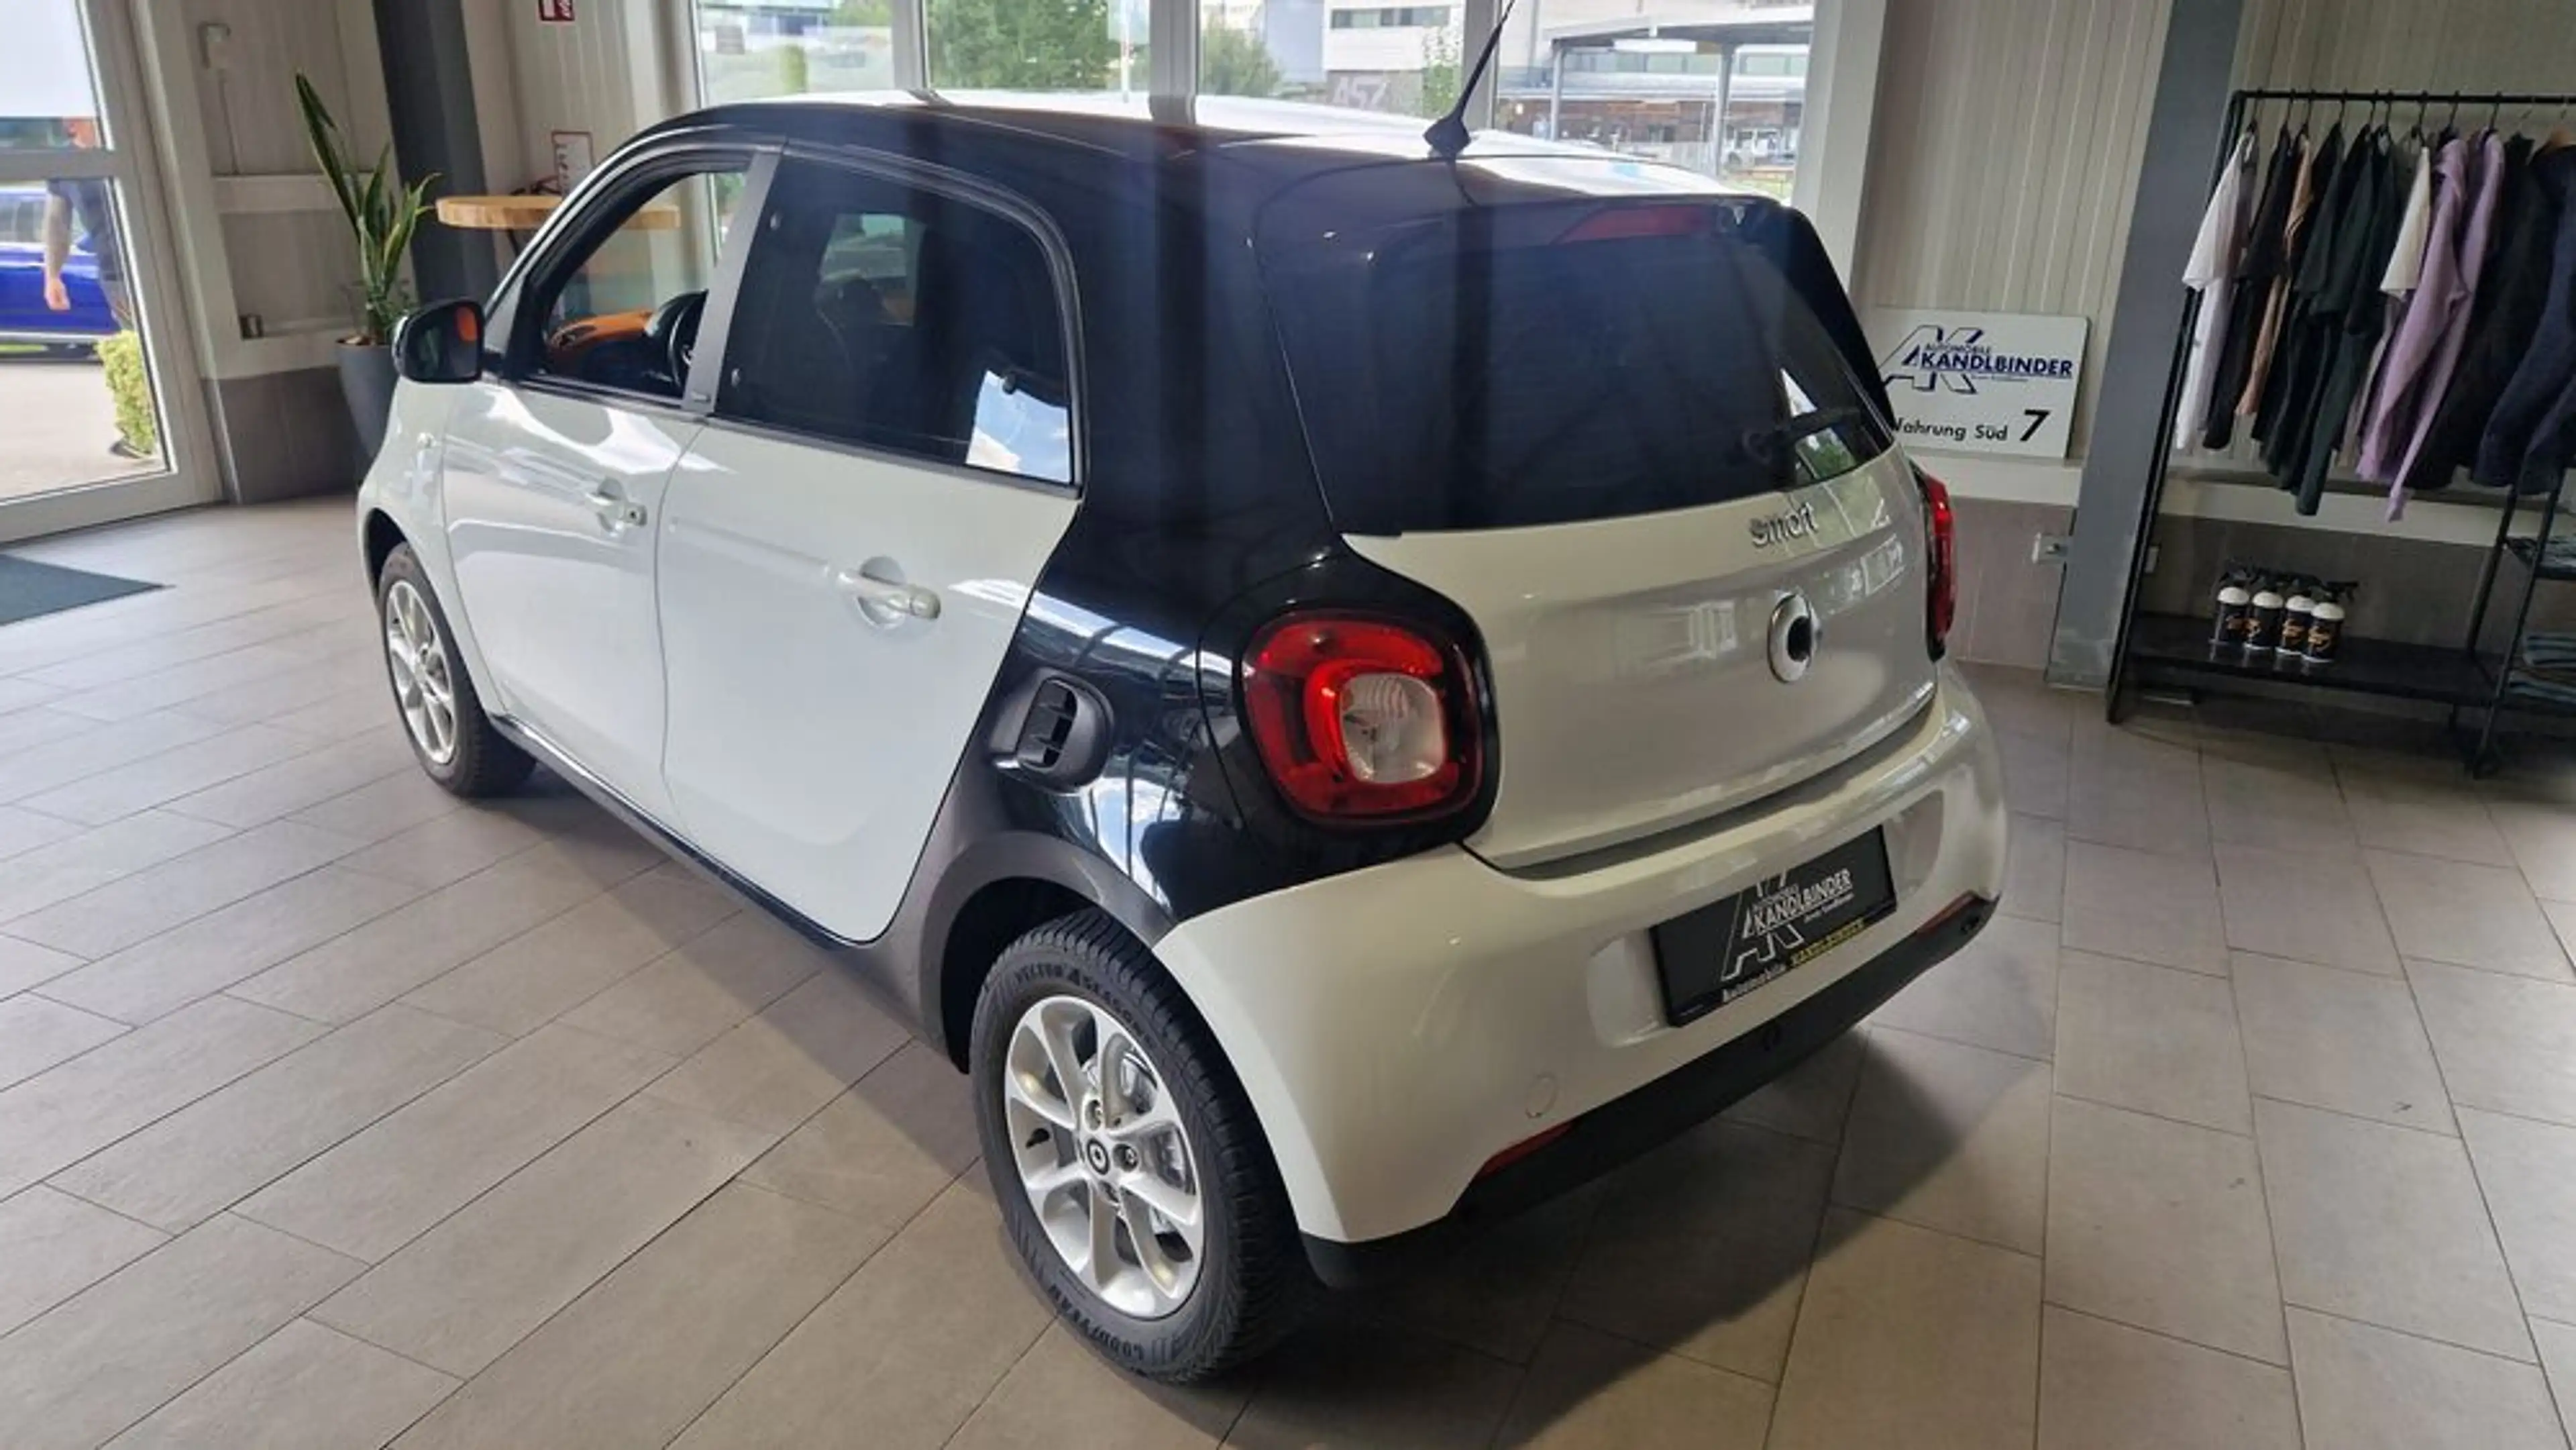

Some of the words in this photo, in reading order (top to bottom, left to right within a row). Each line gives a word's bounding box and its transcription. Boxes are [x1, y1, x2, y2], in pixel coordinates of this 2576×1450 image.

[1921, 352, 2073, 376] KANDLBINDER
[1974, 423, 2008, 441] Süd
[2019, 409, 2051, 442] 7
[1750, 501, 1819, 548] smart
